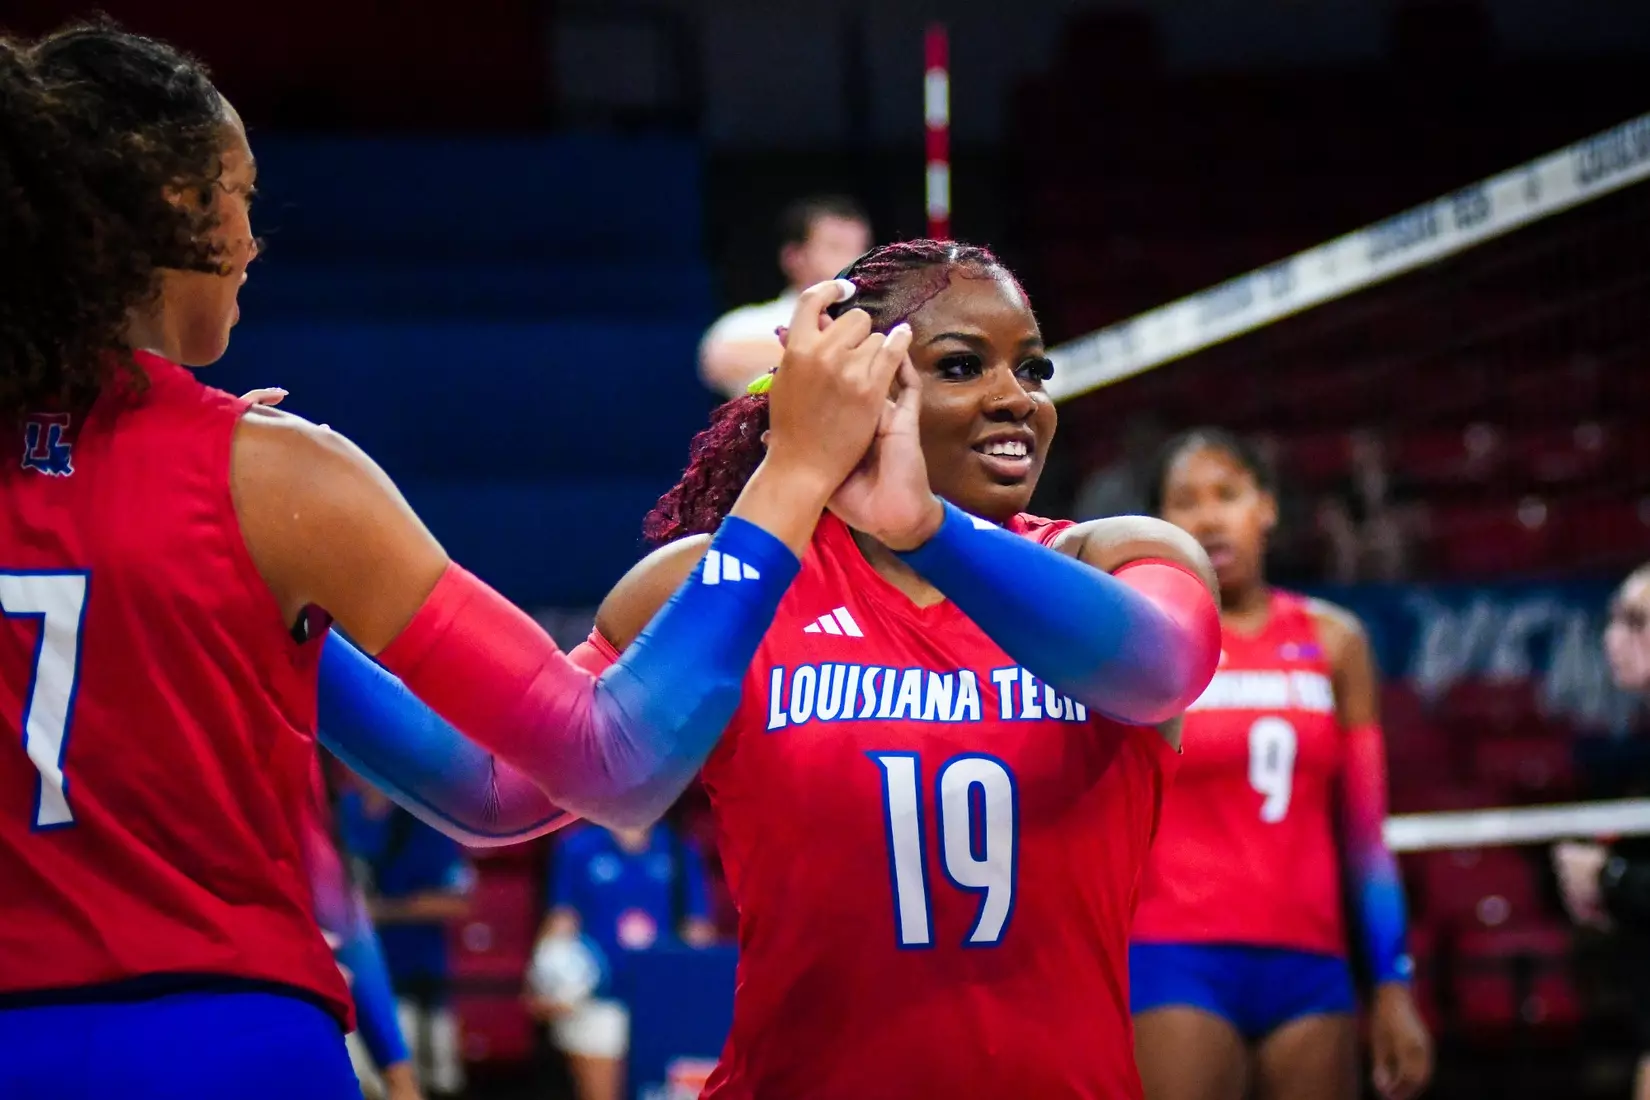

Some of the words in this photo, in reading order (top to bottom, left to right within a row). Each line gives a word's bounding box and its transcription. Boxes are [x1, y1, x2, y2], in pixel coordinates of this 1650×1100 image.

[0, 567, 91, 832] 7
[766, 664, 981, 731] LOUISIANA
[1248, 715, 1298, 823] 9
[867, 752, 1018, 949] 19
